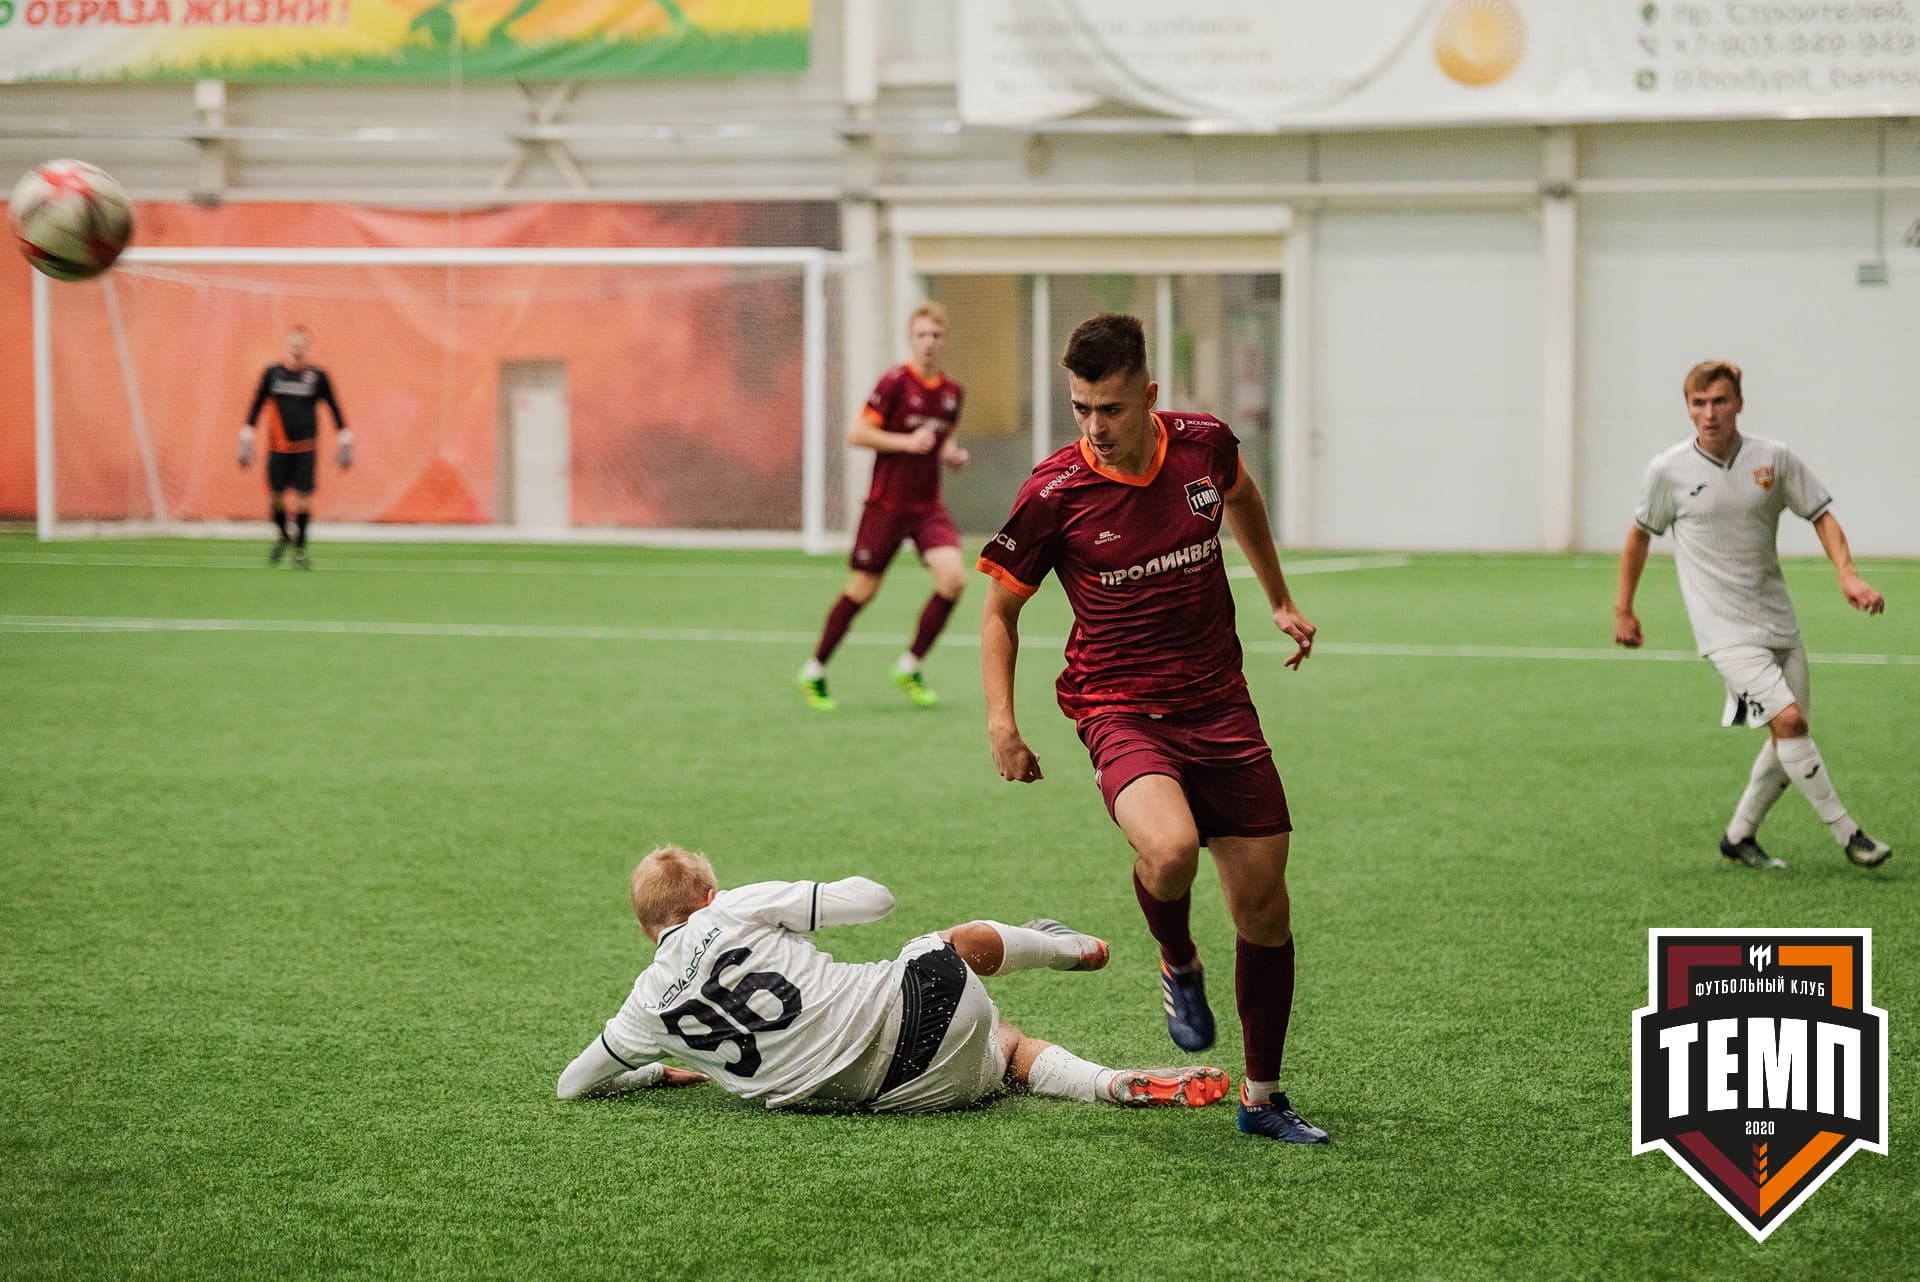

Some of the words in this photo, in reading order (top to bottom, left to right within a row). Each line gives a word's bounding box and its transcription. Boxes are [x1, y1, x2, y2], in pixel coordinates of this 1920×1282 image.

[24, 0, 171, 25] ОБРАЗА
[1190, 488, 1219, 510] ТЕМП
[991, 532, 1017, 552] СБ
[660, 947, 803, 1078] 96
